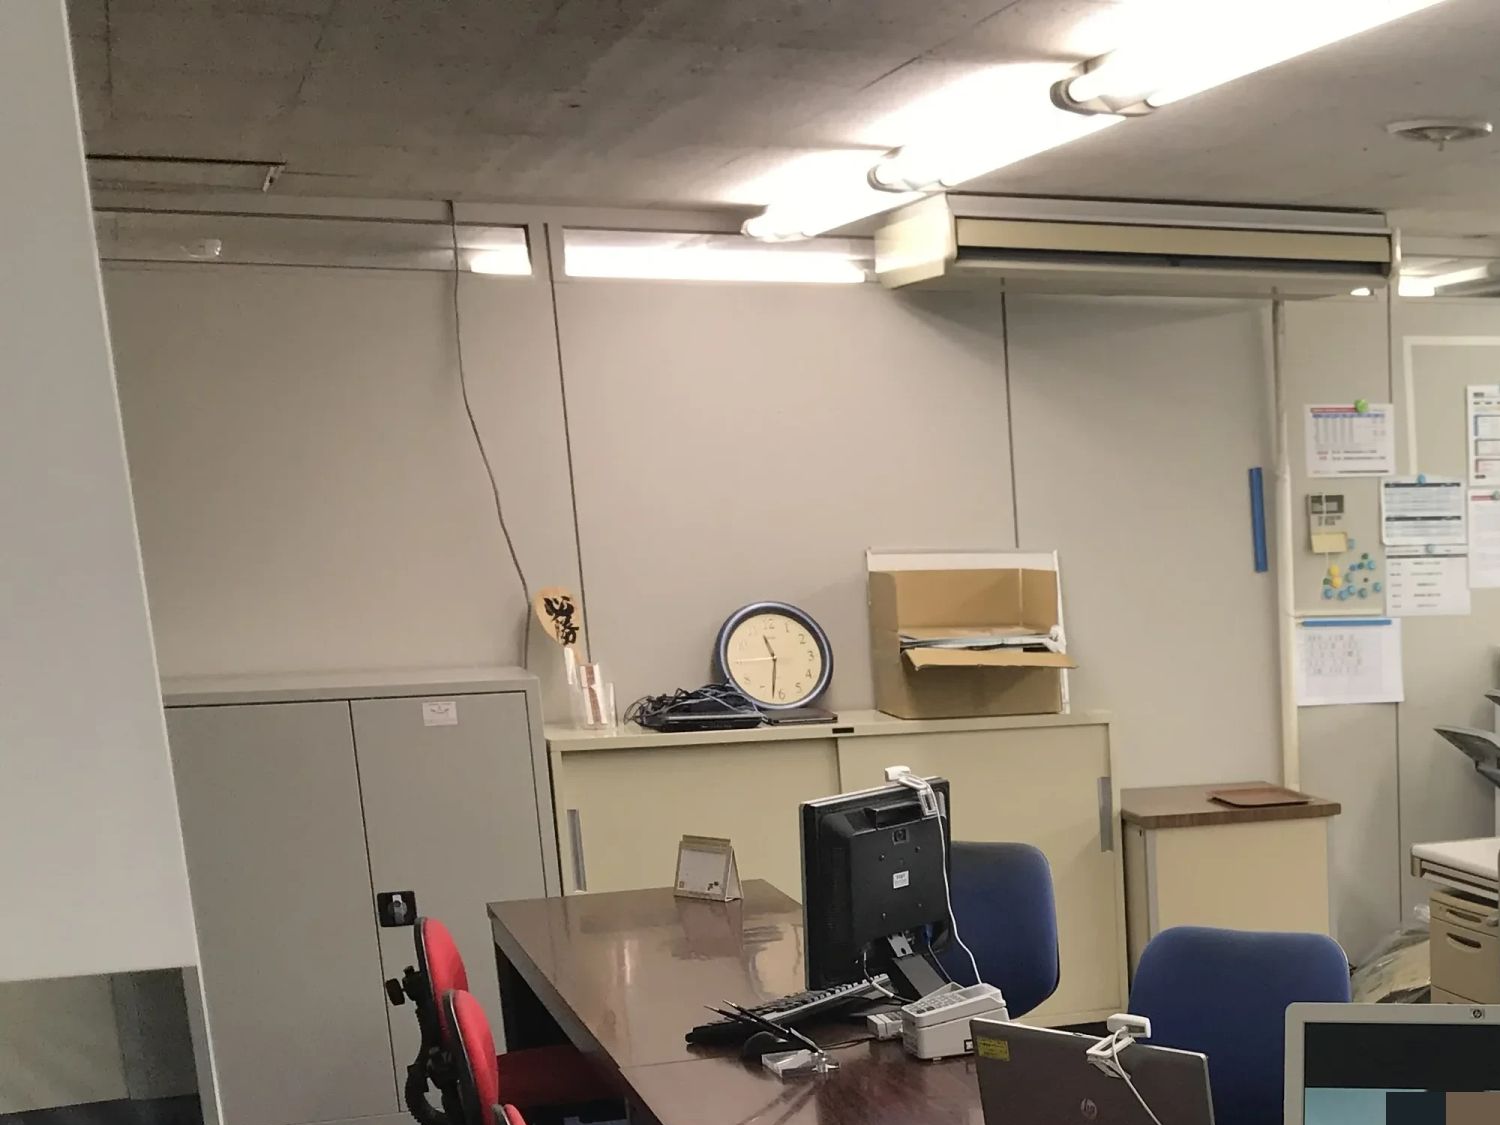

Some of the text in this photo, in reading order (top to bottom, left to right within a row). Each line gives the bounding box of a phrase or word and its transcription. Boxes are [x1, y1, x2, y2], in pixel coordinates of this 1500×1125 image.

[798, 633, 807, 645] 2
[807, 650, 815, 662] 3
[805, 669, 812, 679] 4
[795, 682, 802, 693] 5
[778, 688, 786, 700] 6
